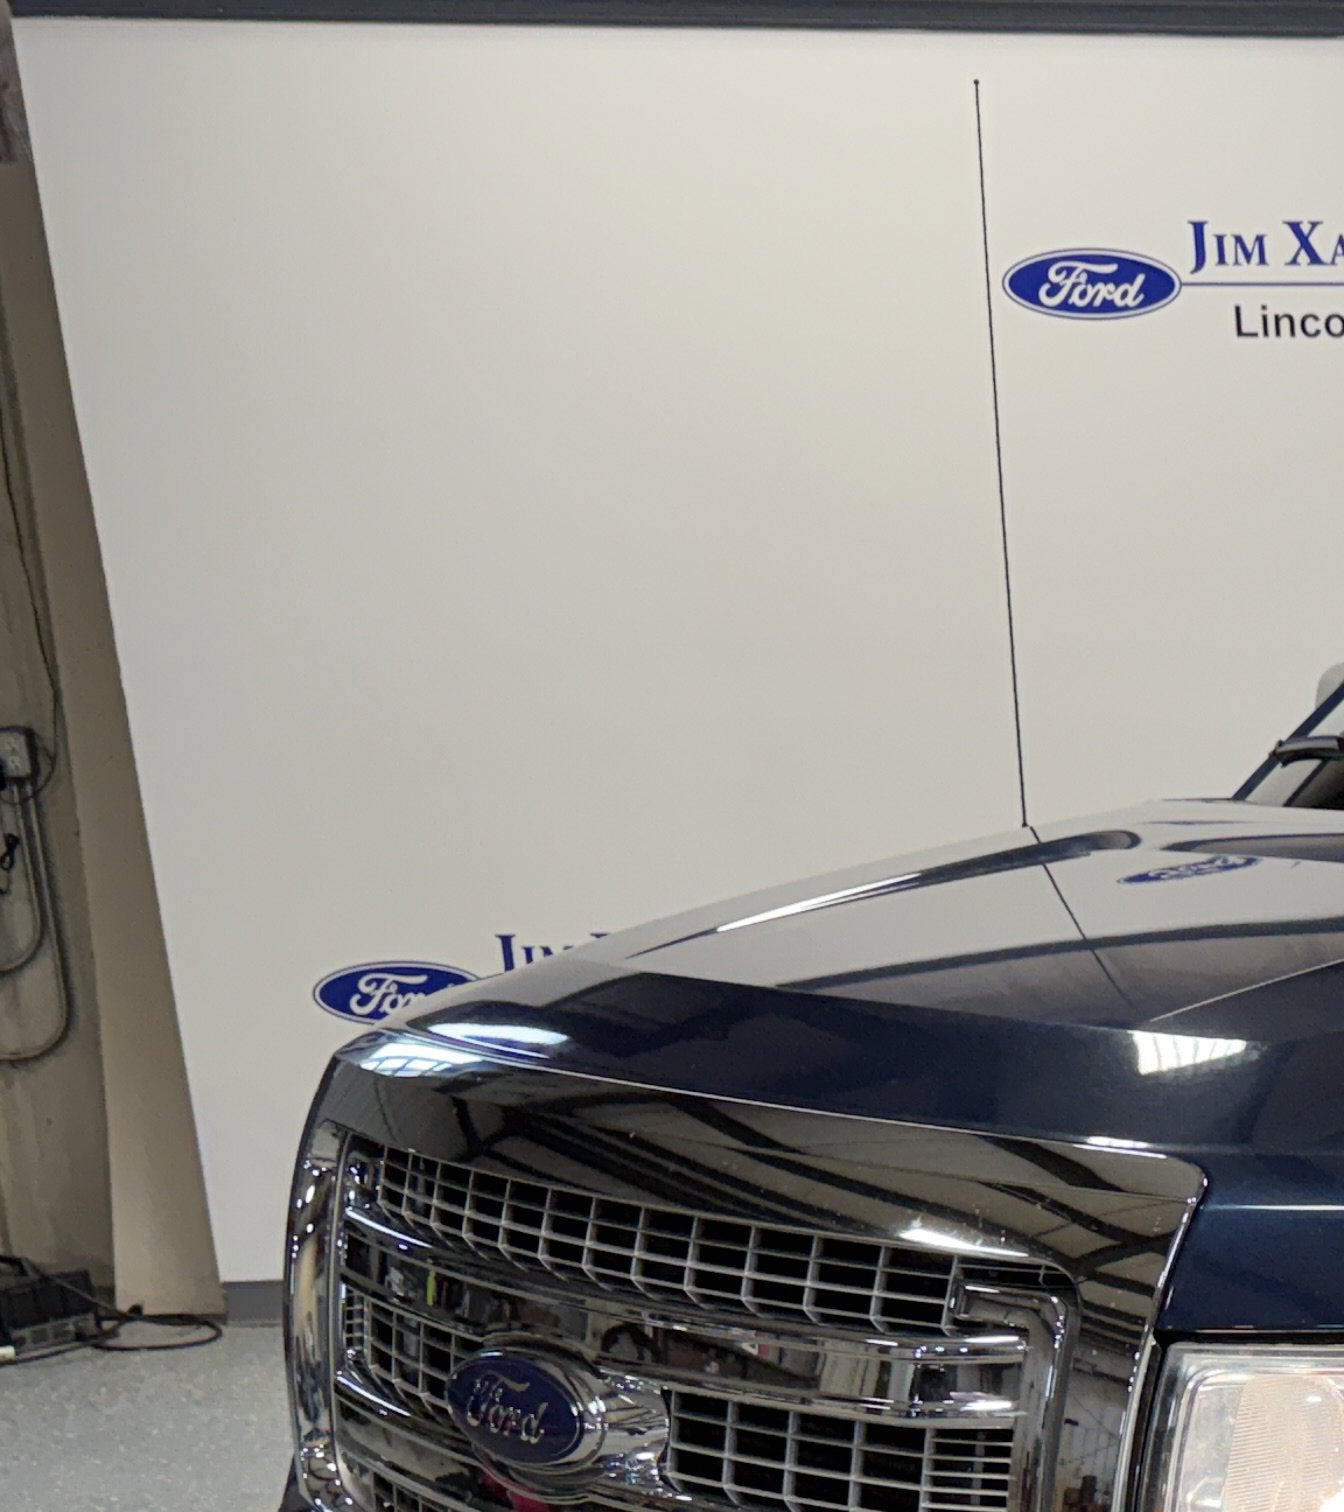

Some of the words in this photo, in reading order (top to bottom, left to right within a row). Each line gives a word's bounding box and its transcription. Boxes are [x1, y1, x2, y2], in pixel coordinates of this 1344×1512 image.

[1187, 220, 1267, 275] JIM
[1039, 261, 1144, 309] Ford
[495, 934, 574, 973] JI
[467, 1370, 548, 1444] Ford
